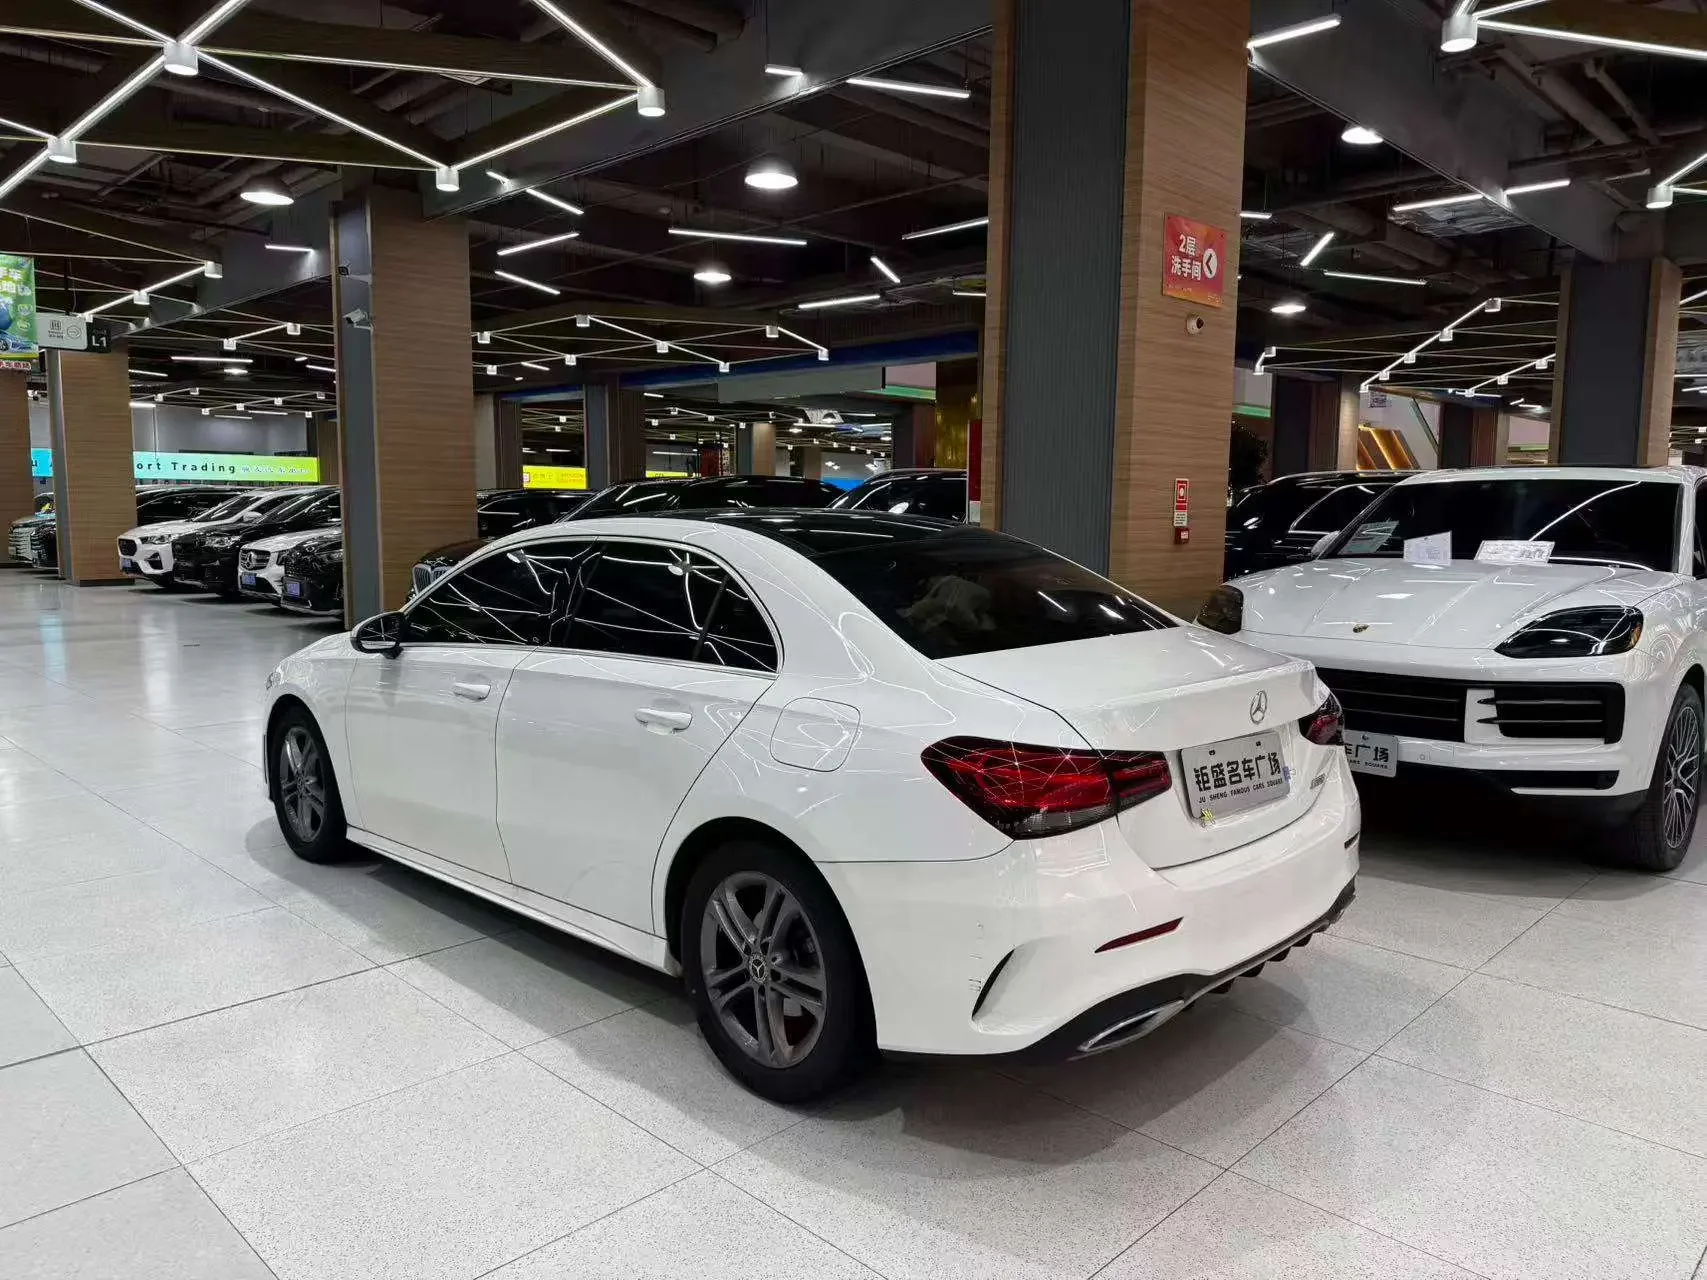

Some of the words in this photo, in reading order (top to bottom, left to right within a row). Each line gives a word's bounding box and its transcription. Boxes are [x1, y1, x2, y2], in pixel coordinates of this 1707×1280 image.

[1178, 233, 1196, 256] 2层
[1171, 254, 1202, 281] 洗手间
[92, 334, 107, 347] L1
[171, 461, 235, 474] Trading
[1199, 796, 1206, 804] JU
[1209, 791, 1228, 801] SHENG
[1230, 786, 1251, 796] FAMOUS
[1252, 782, 1265, 791] CARS
[1266, 778, 1283, 788] SQUARE
